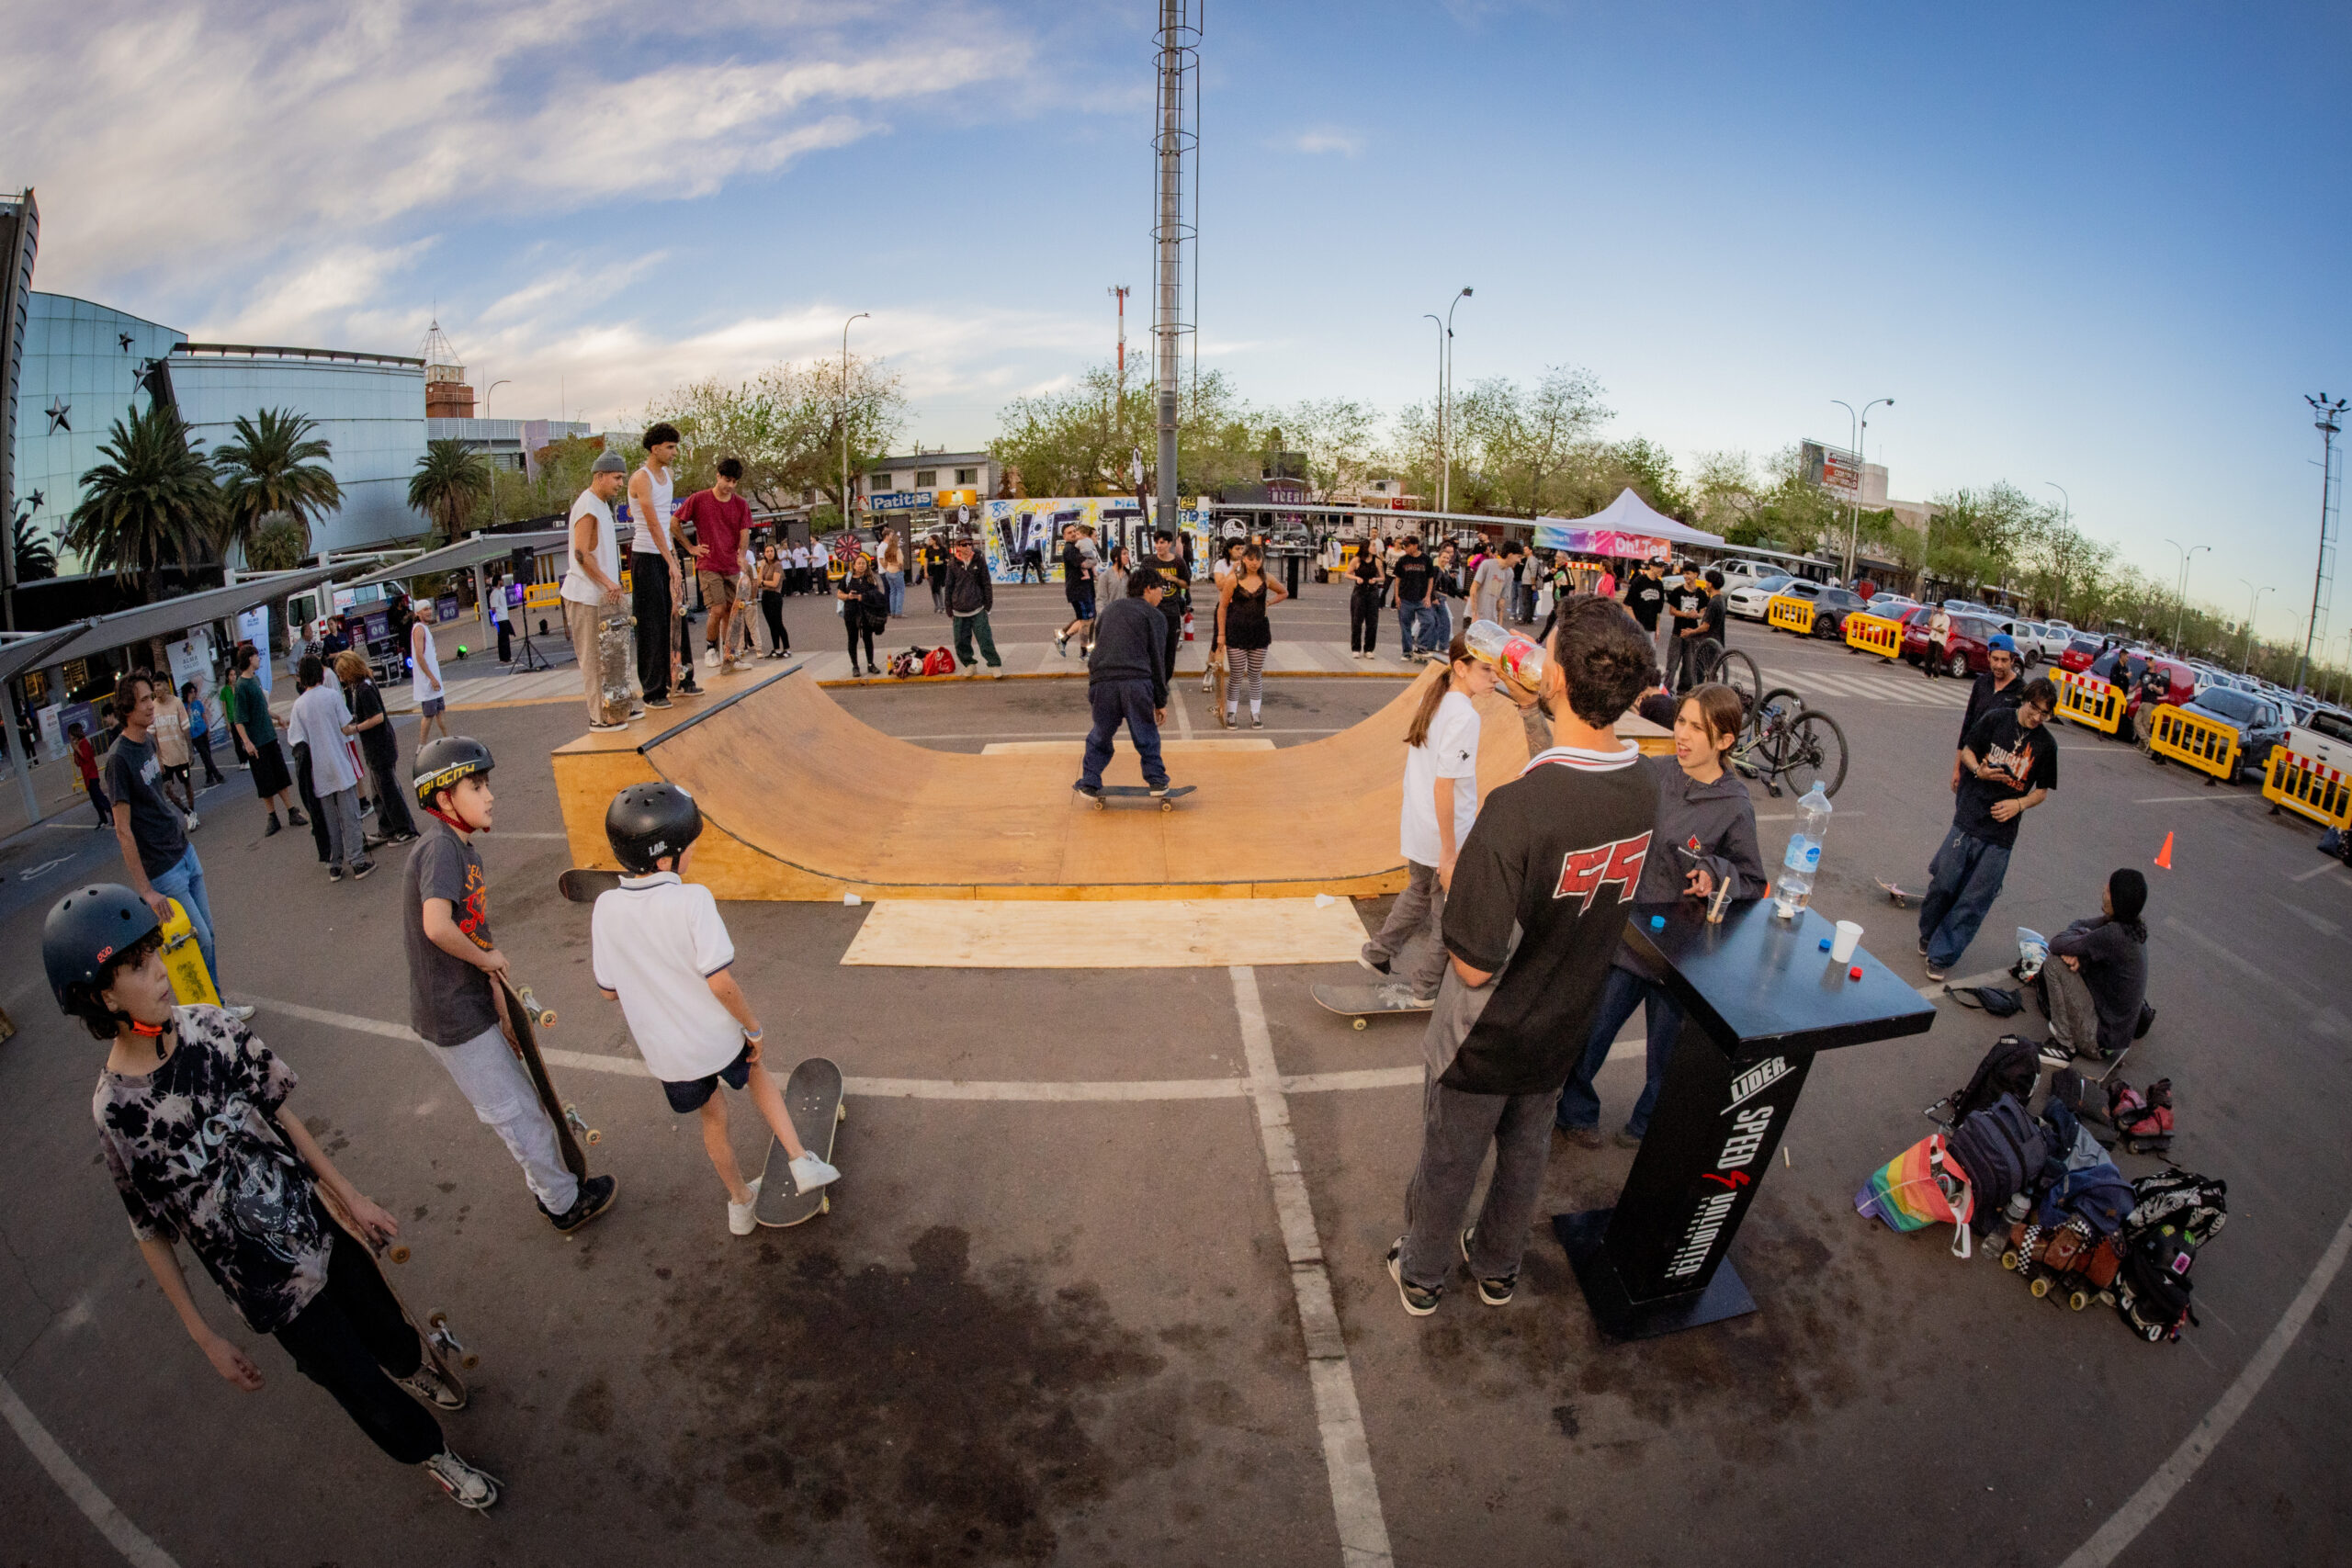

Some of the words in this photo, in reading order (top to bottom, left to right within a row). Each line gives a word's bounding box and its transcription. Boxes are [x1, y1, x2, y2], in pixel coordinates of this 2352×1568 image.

[874, 493, 931, 509] Patitas
[1614, 536, 1640, 555] Oh!
[1642, 540, 1668, 558] Tea
[1731, 1055, 1787, 1102] LIDER
[1717, 1105, 1774, 1169] SPEED
[1675, 1191, 1738, 1276] UNLIMITED
